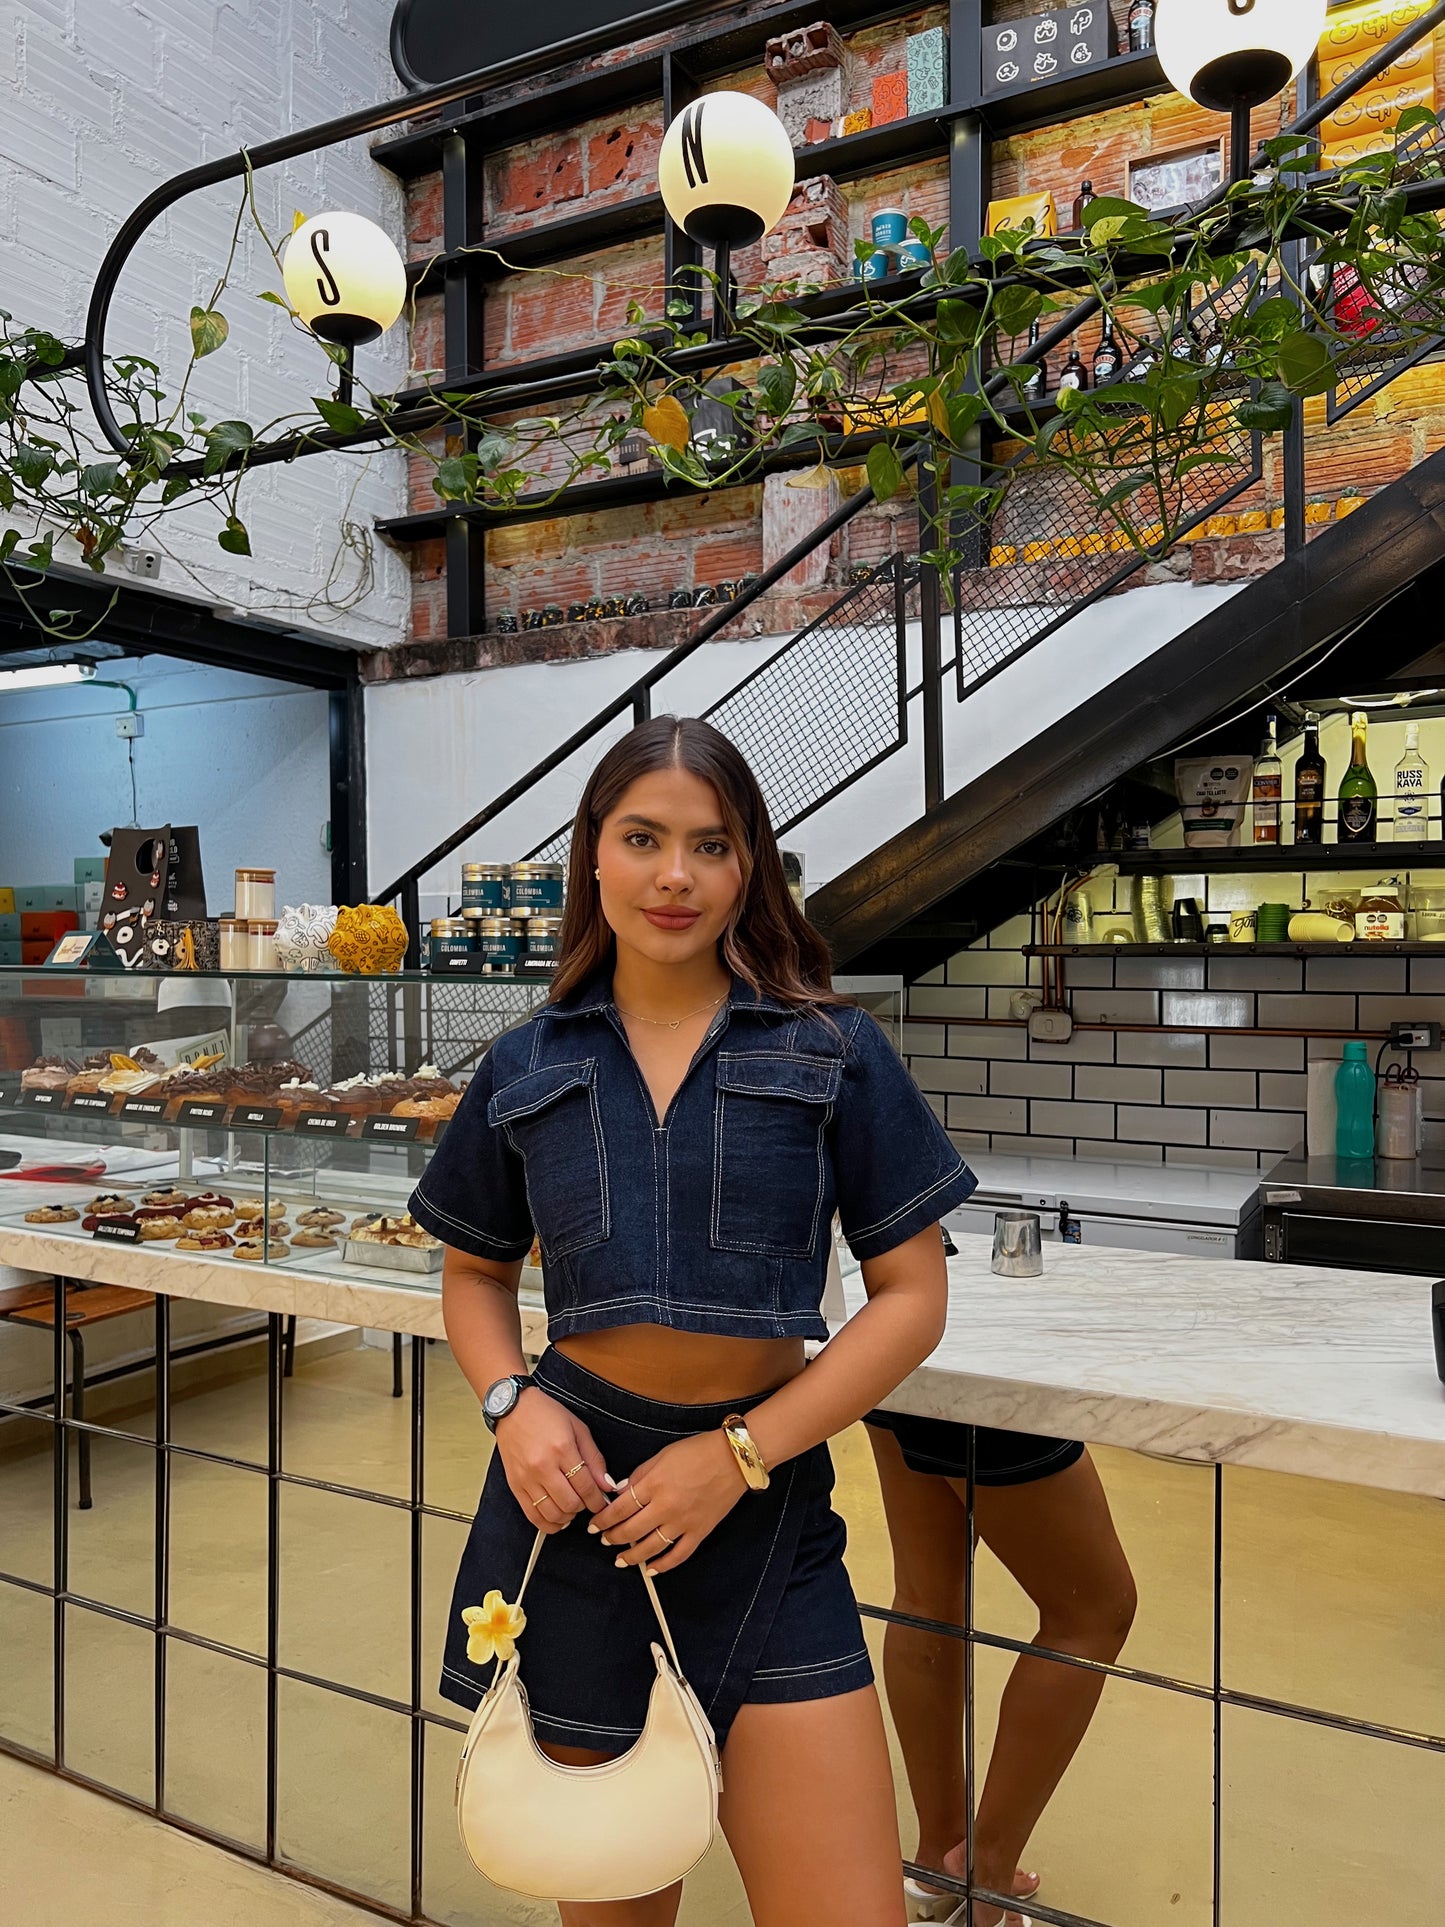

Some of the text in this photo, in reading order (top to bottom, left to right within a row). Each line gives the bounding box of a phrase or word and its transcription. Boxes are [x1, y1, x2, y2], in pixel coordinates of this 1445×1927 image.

[682, 101, 709, 189] N
[310, 229, 340, 306] S
[1397, 770, 1423, 779] RUSS
[1397, 778, 1423, 789] KAYA
[516, 888, 542, 896] COLOMBIA
[441, 944, 468, 952] COLOMBIA
[482, 944, 506, 952] COLOMBIA
[529, 944, 554, 952] COLOMBIA
